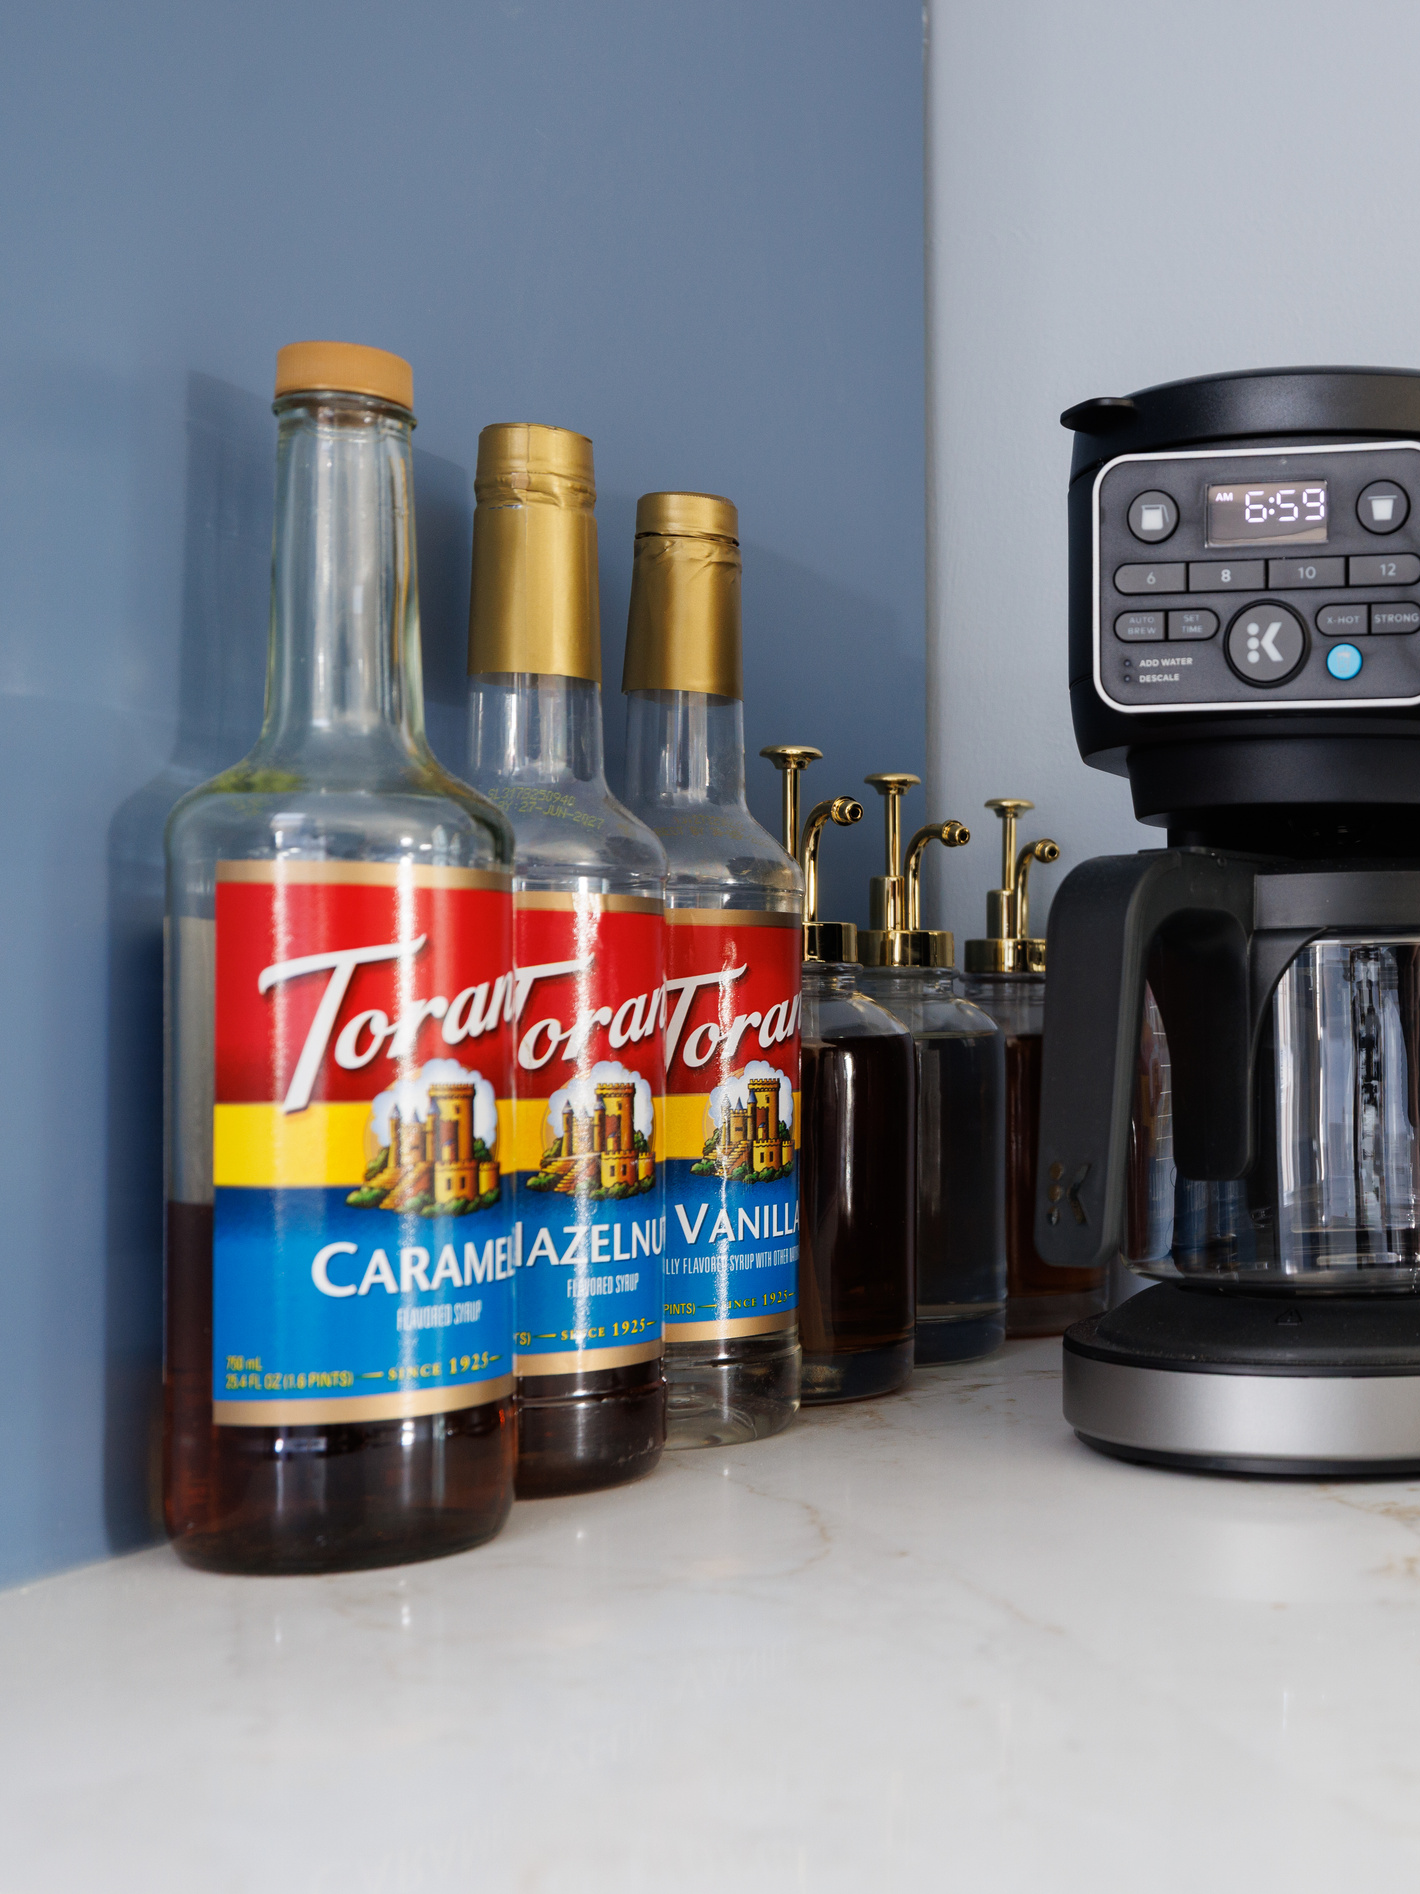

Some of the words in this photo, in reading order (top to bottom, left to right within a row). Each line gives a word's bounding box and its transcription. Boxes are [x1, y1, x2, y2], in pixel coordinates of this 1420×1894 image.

[1215, 491, 1234, 502] AM
[1245, 488, 1325, 523] 6:59
[1220, 569, 1232, 583] 8
[1299, 566, 1317, 580] 10
[1380, 562, 1397, 577] 12
[1146, 571, 1156, 585] 6
[1129, 616, 1155, 624] AUTO
[1183, 614, 1200, 622] SET
[1326, 616, 1360, 624] X-HOT
[1373, 612, 1420, 624] STRONG
[1127, 627, 1157, 635] BREW
[1182, 625, 1204, 633] TIME
[1139, 659, 1160, 668] ADD
[1160, 657, 1194, 667] WATER
[1139, 673, 1180, 683] DESCALE
[311, 1235, 516, 1298] CARAMEL
[729, 1252, 756, 1272] SYRUP
[755, 1249, 773, 1269] WITH
[615, 1272, 640, 1294] SYRUP
[727, 1297, 758, 1310] INCE
[762, 1289, 788, 1307] 1925
[396, 1302, 453, 1332] FLAVORED
[453, 1300, 482, 1326] SYRUP
[612, 1317, 646, 1337] 1925
[248, 1372, 262, 1391] FL
[263, 1371, 283, 1391] OZ
[308, 1369, 354, 1389] PINTS)
[387, 1363, 442, 1382] SINCE
[448, 1351, 490, 1375] 1925
